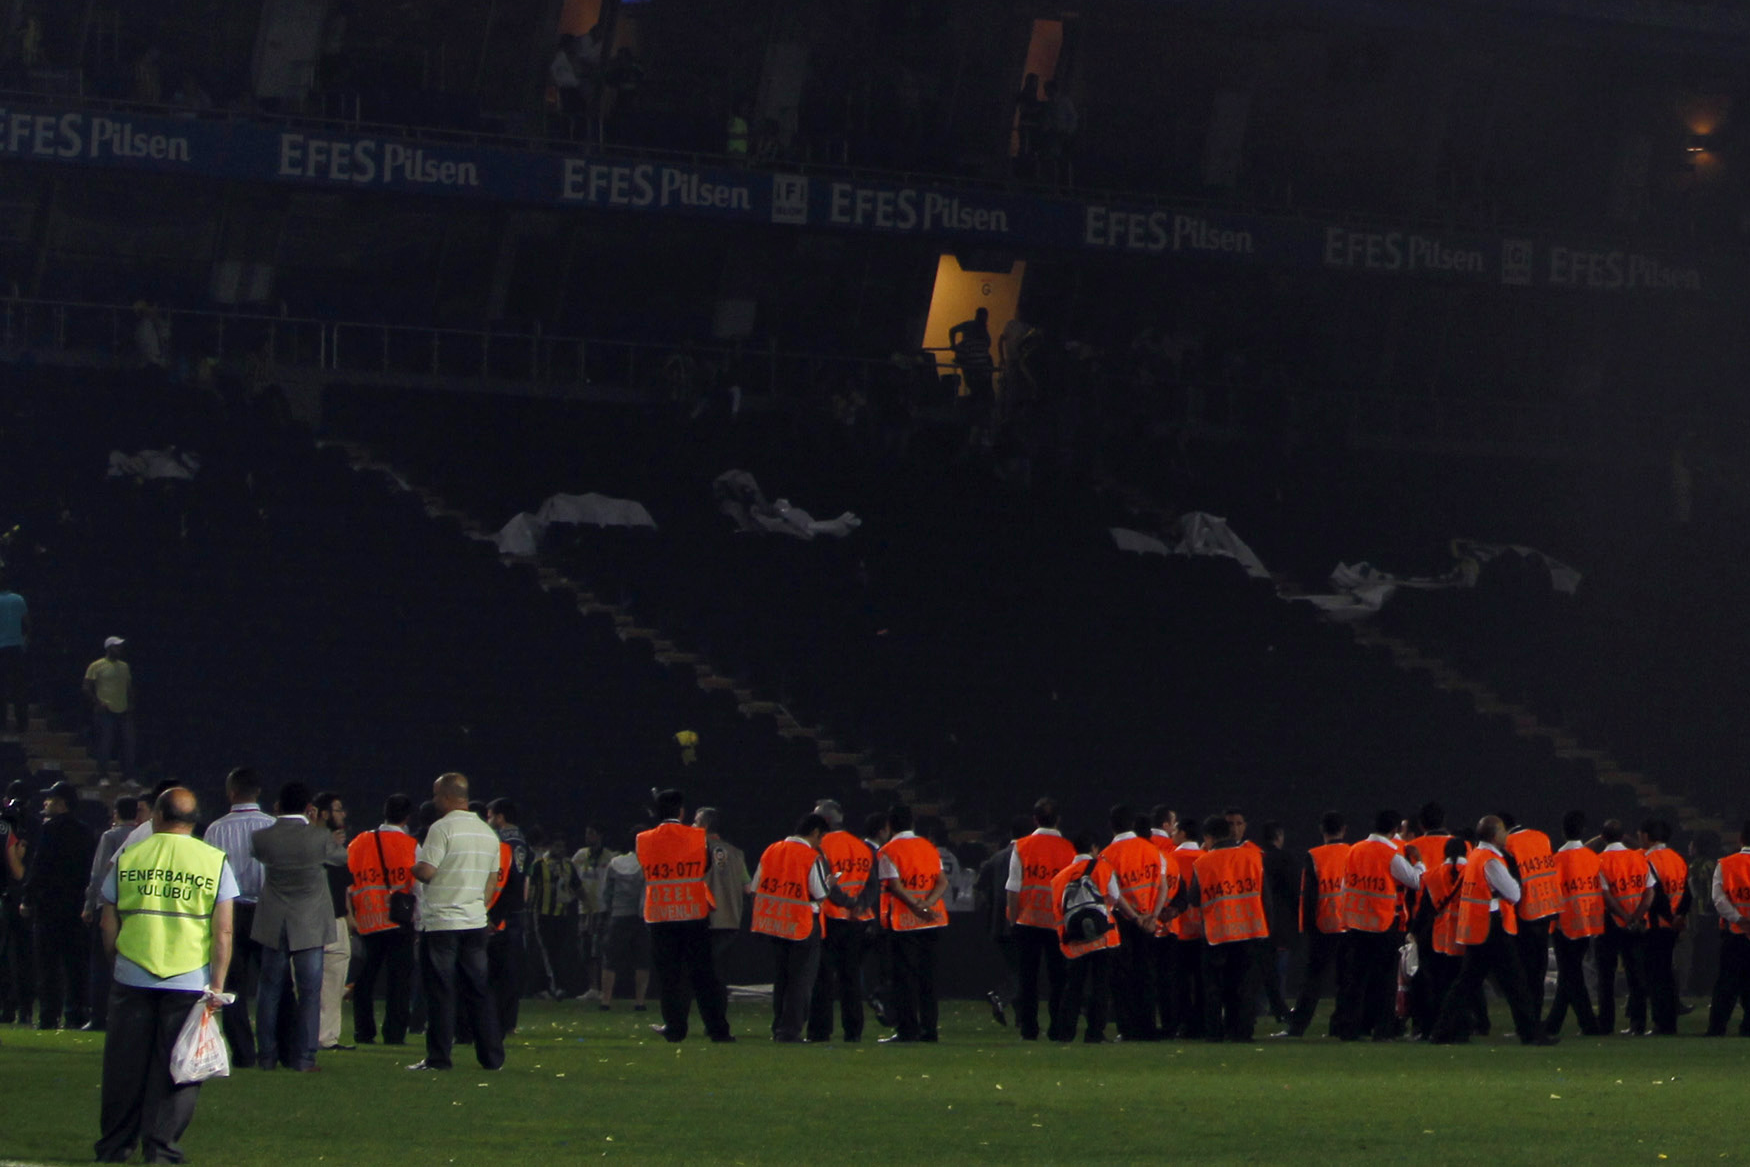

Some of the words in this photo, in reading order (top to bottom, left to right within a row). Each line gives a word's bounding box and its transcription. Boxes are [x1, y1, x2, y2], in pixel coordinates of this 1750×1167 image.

[0, 108, 83, 158] FES
[90, 117, 191, 162] Pilsen
[279, 133, 376, 183] EFES
[383, 143, 480, 186] Pilsen
[563, 158, 654, 206] EFES
[661, 168, 751, 210] Pilsen
[831, 182, 917, 230] EFES
[923, 193, 1009, 233] Pilsen
[1085, 205, 1168, 251] EFES
[1173, 214, 1255, 253] Pilsen
[1323, 227, 1403, 271] EFES
[1408, 235, 1484, 274] Pilsen
[982, 283, 993, 296] G
[1549, 246, 1624, 288] EFES
[1627, 254, 1702, 291] Pilsen
[119, 869, 214, 891] FENERBAHÇE
